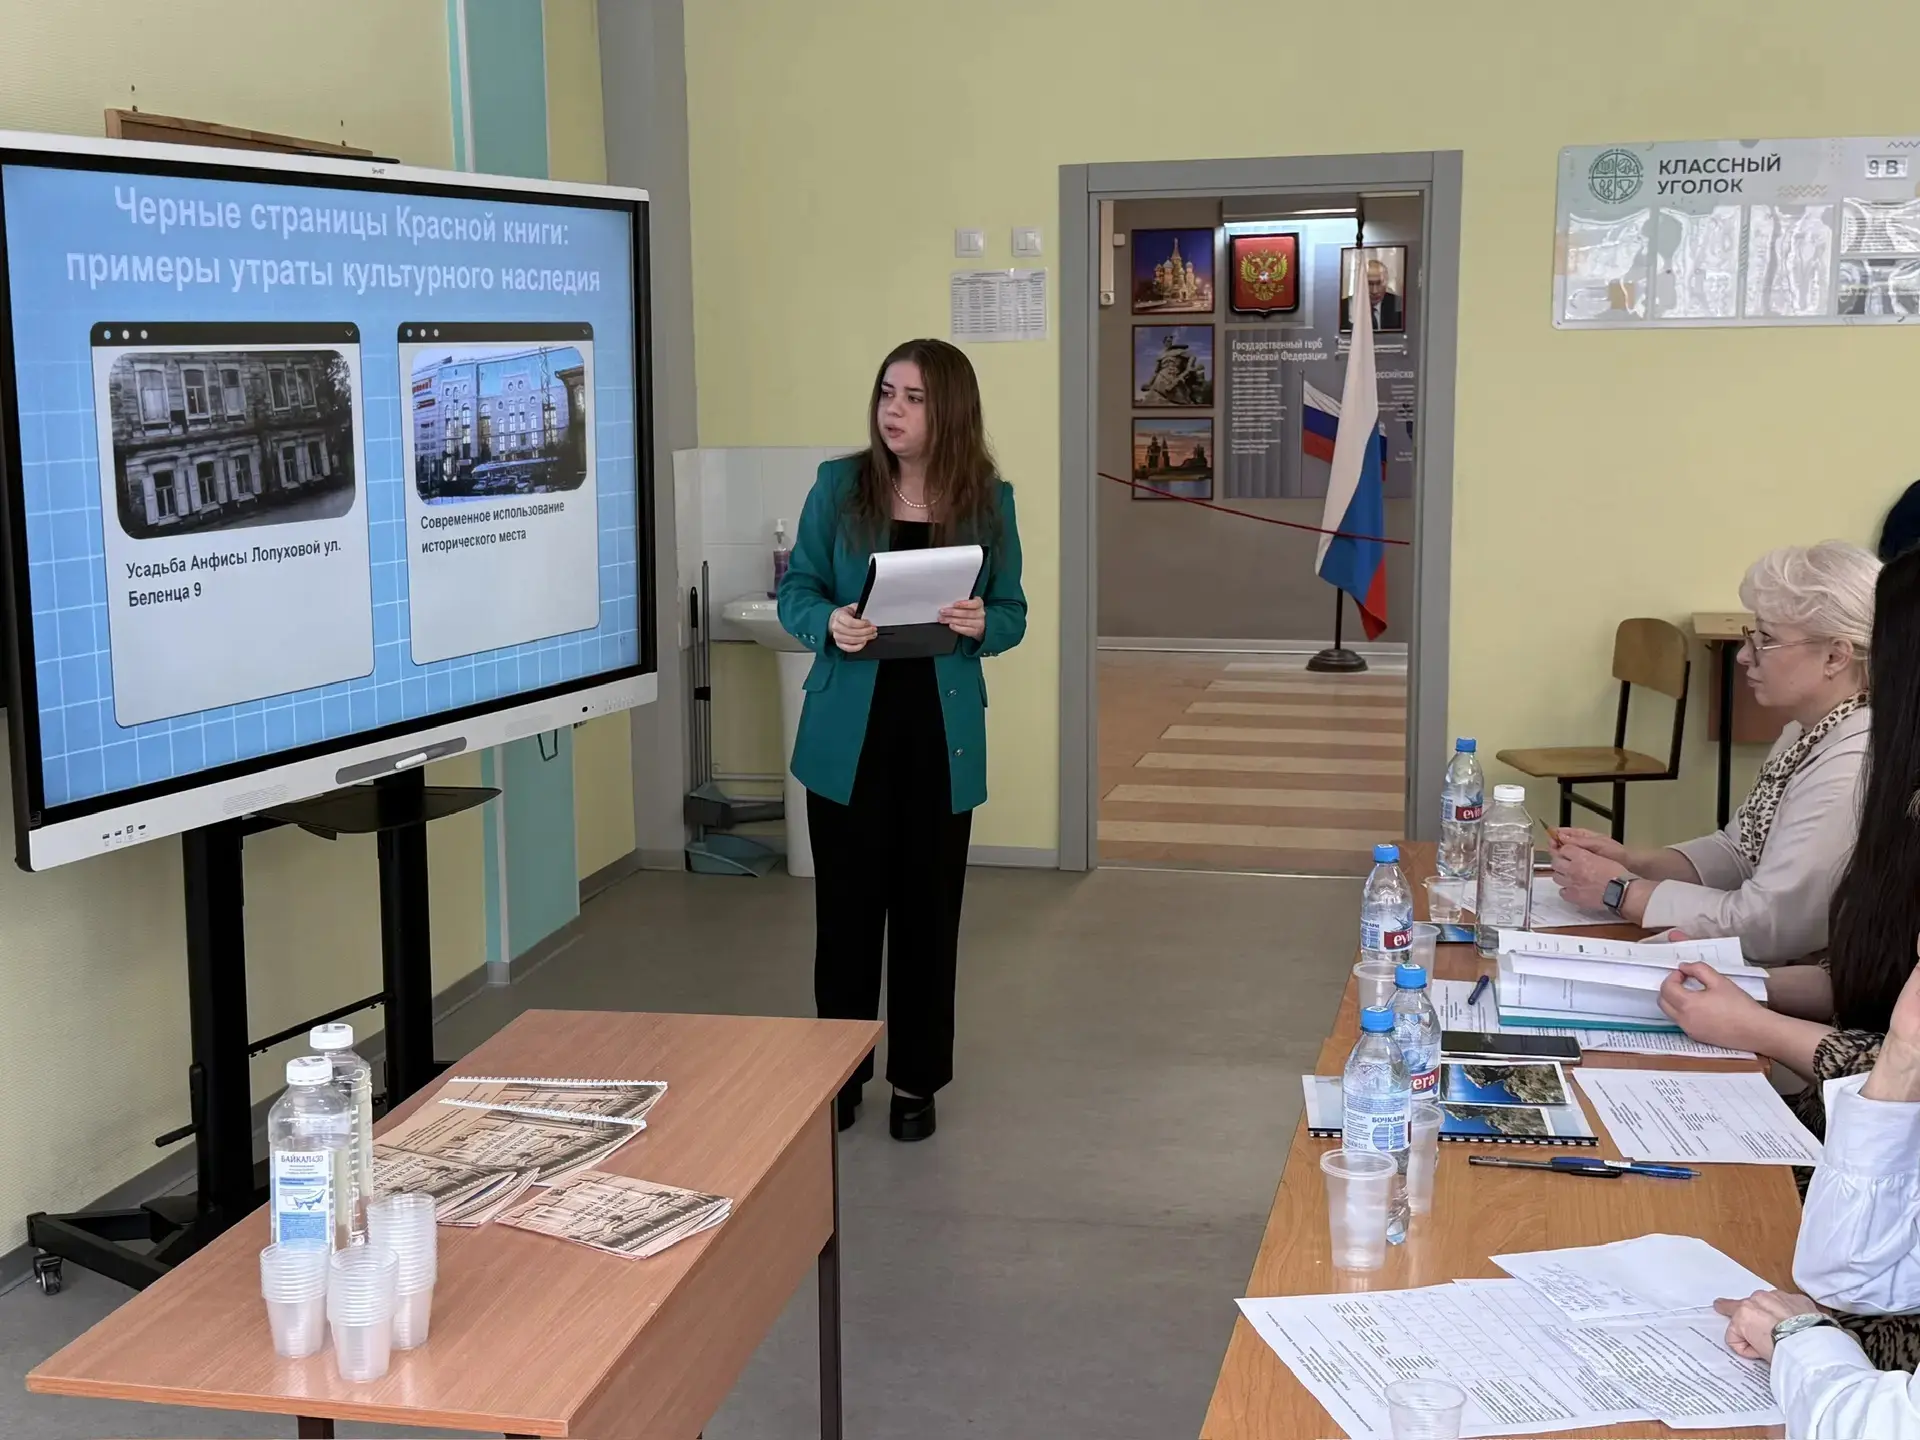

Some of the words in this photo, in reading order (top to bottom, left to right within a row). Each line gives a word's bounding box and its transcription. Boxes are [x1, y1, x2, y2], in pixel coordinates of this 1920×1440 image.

[1658, 153, 1781, 175] КЛАССНЫЙ
[1657, 178, 1744, 195] УГОЛОК
[114, 185, 242, 235] Черные
[250, 202, 388, 241] страницы
[396, 205, 496, 246] Красной
[503, 220, 569, 246] книги:
[66, 252, 220, 292] примеры
[228, 258, 333, 293] утраты
[343, 262, 494, 297] культурного
[501, 268, 600, 295] наследия
[1231, 339, 1303, 351] Государственный
[1304, 337, 1323, 350] герб
[1231, 351, 1279, 361] Российской
[1280, 351, 1328, 362] Федерации
[420, 510, 491, 531] Современное
[493, 501, 565, 521] использование
[421, 533, 497, 554] исторического
[499, 529, 527, 543] места
[126, 557, 187, 579] Усадьба
[190, 551, 248, 572] Анфисы
[251, 539, 321, 563] Лопуховой
[324, 540, 342, 557] ул.
[128, 585, 190, 608] Беленца
[193, 582, 202, 598] 9
